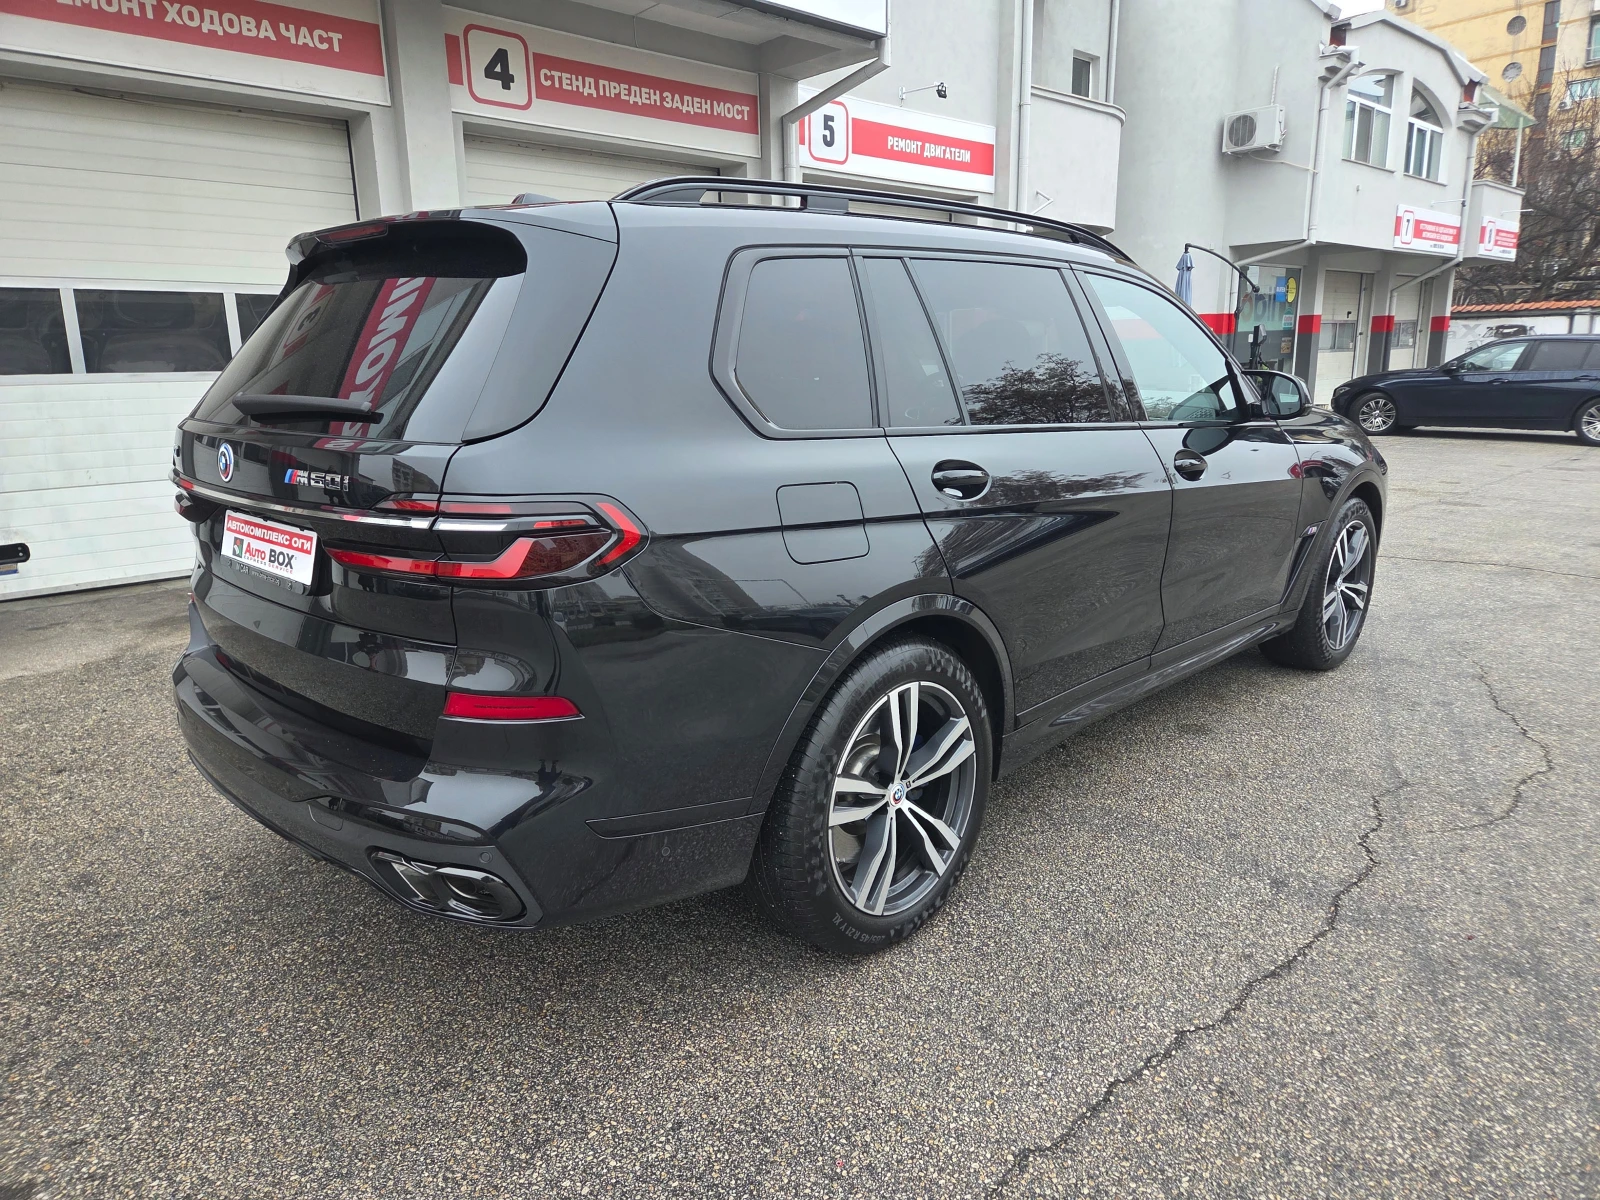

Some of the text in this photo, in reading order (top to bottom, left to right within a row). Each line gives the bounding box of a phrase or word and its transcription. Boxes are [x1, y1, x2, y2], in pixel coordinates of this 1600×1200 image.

[163, 1, 277, 42] ХОДОВА
[279, 23, 343, 53] ЧАСТ
[484, 48, 515, 91] 4
[540, 68, 750, 121] СТЕНД ПРЕДЕН ЗАДЕН МОСТ
[822, 114, 835, 148] 5
[888, 135, 971, 163] РЕМОНТ ДВИГАТЕЛИ
[228, 520, 312, 551] АВТОКОМПЛЕКС ОГИ
[269, 548, 294, 569] BOX
